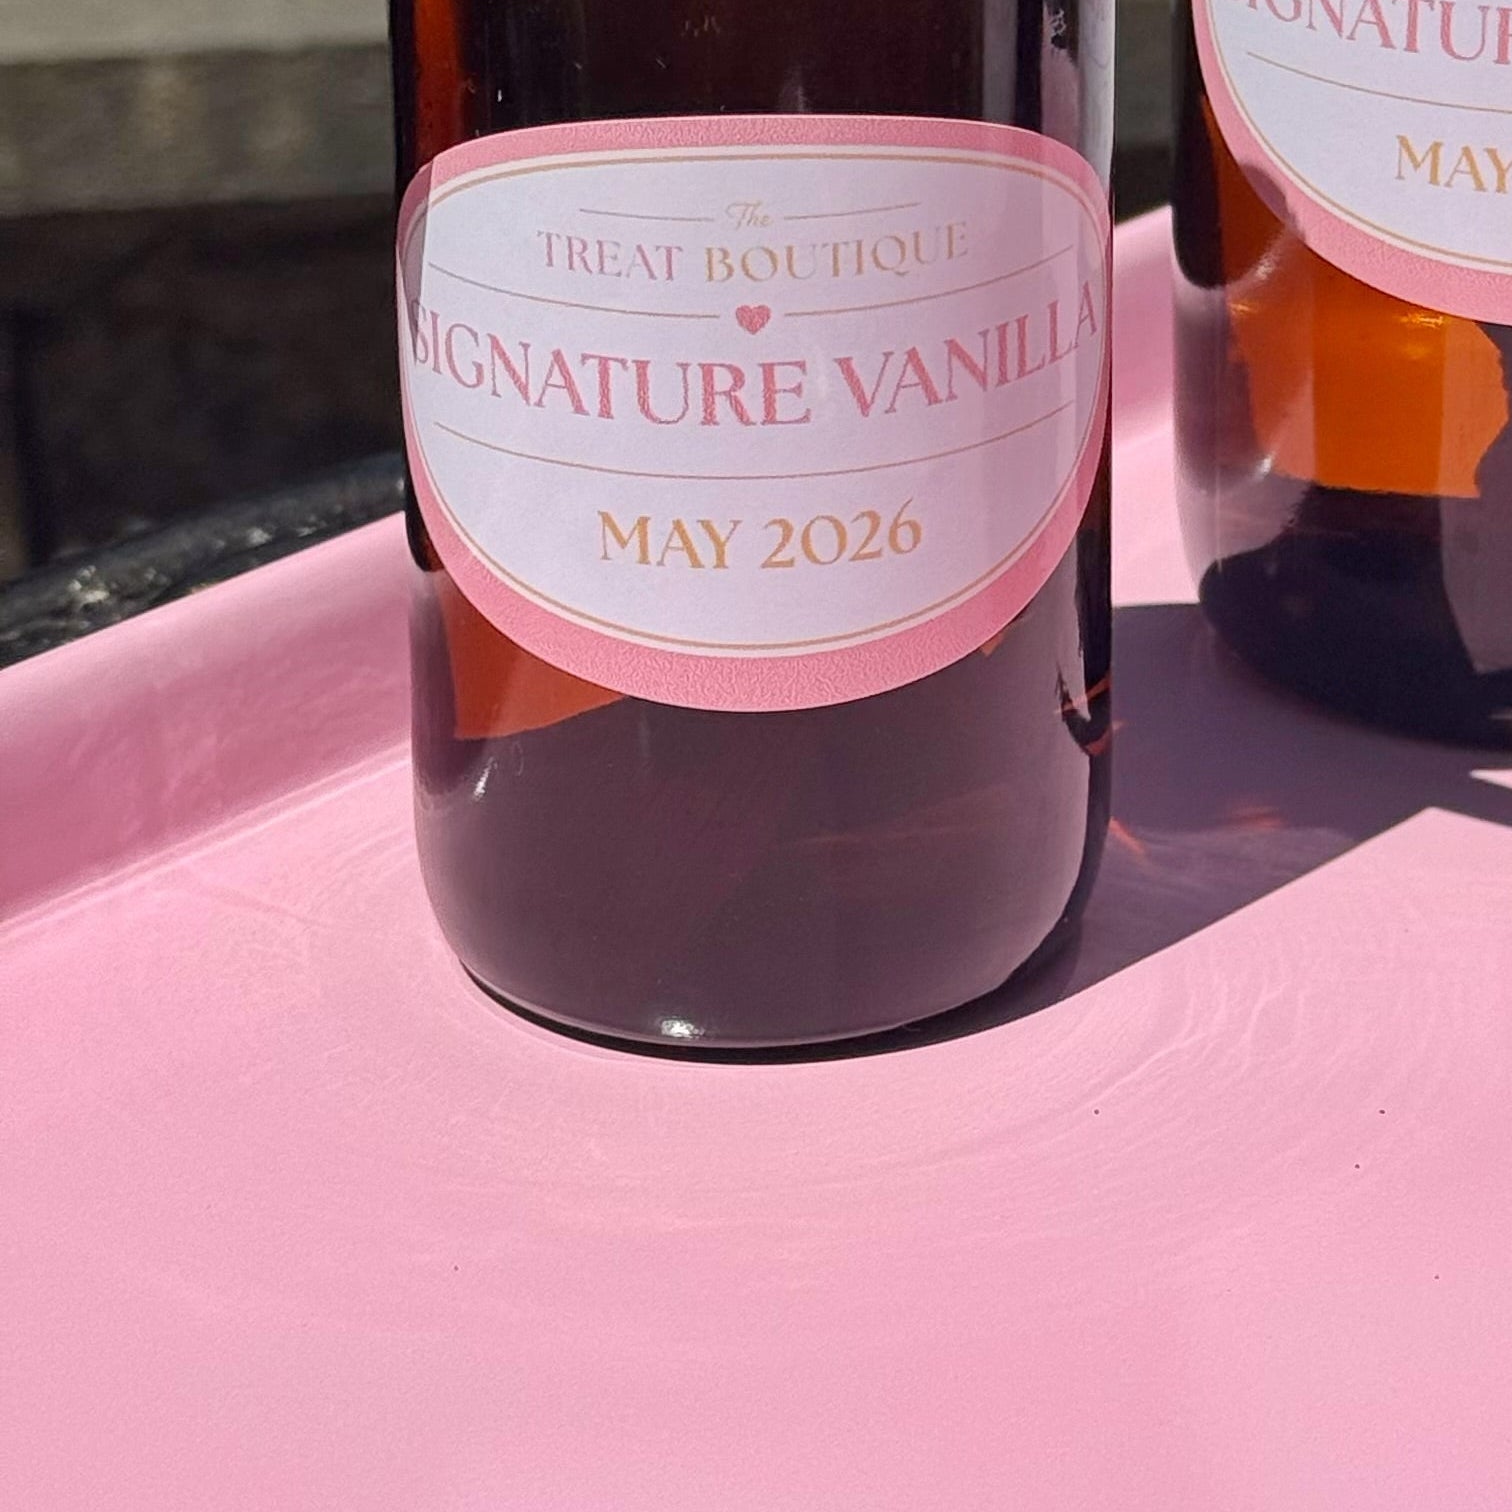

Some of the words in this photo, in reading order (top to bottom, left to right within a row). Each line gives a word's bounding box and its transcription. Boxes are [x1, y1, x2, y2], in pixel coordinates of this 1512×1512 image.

[725, 201, 770, 229] The
[537, 229, 683, 282] TREAT
[704, 222, 968, 284] BOUTIQUE
[412, 298, 811, 426] SIGNATURE
[834, 280, 1098, 418] VANILLA
[599, 510, 739, 569] MAY
[760, 498, 922, 568] 2026
